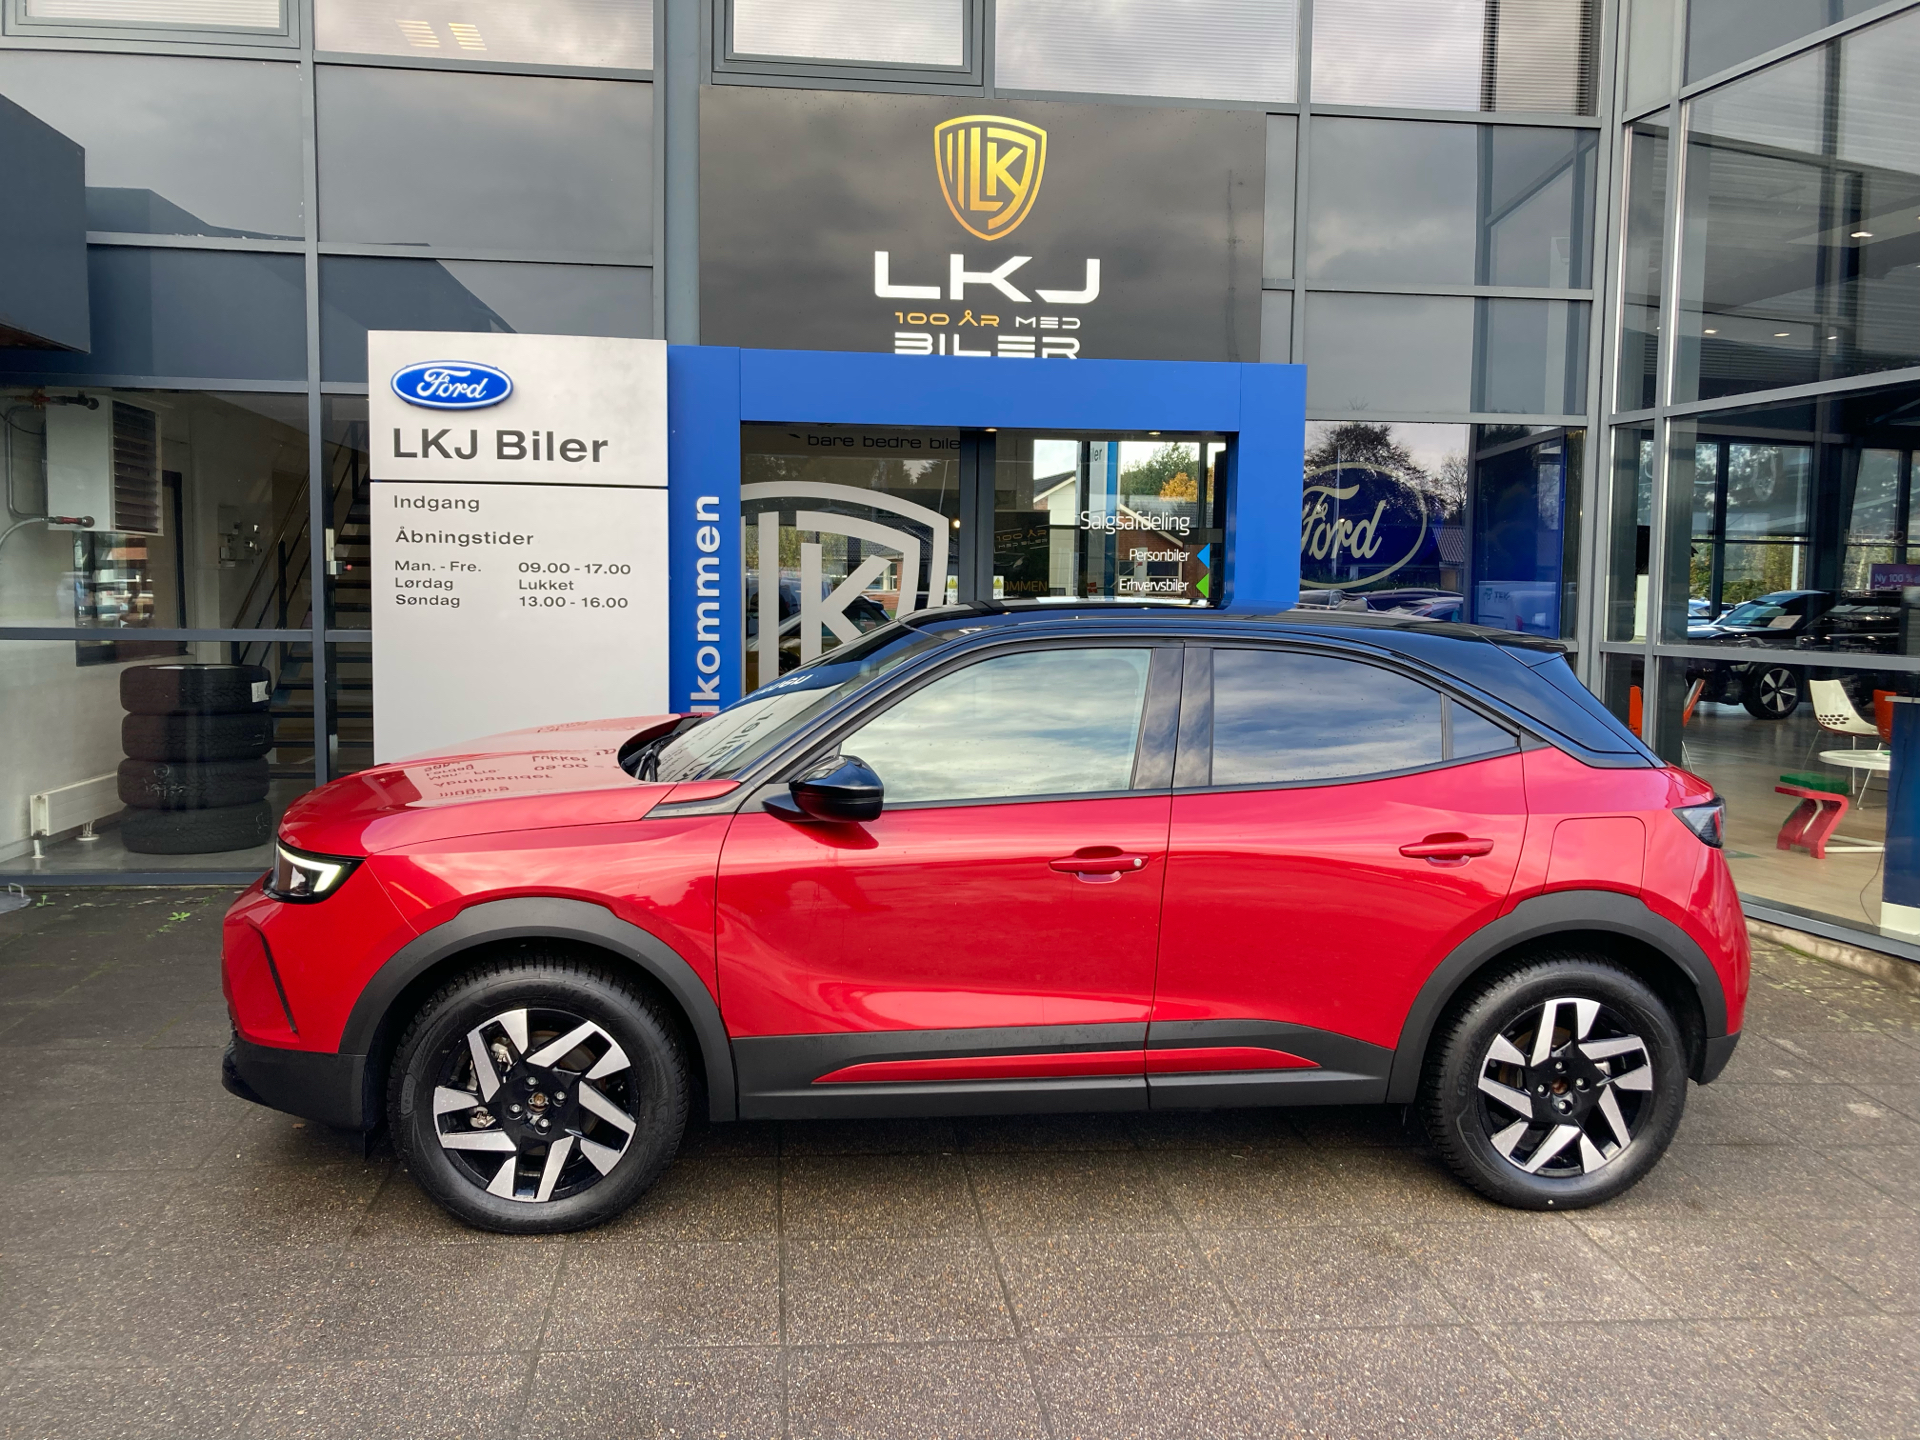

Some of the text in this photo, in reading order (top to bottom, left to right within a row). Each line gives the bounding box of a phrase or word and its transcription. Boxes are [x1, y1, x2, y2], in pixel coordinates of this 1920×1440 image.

[874, 250, 1101, 304] LKJ
[894, 309, 1081, 329] 100 ÅR MED
[894, 331, 1081, 359] BILER
[416, 368, 489, 398] Ford
[393, 427, 609, 463] LKJ Biler
[807, 434, 855, 447] bare
[863, 435, 922, 449] bedre
[393, 494, 480, 513] Indgang
[1080, 511, 1191, 535] Salgsafdeling
[395, 526, 534, 547] Åbningstider
[996, 533, 1023, 541] 100
[1129, 548, 1190, 561] Personbiler
[394, 560, 436, 571] Man.
[449, 561, 482, 572] Fre.
[394, 577, 574, 591] Lørdag Lukket
[1119, 578, 1189, 591] Erhvervsbiler
[395, 594, 461, 608] Søndag
